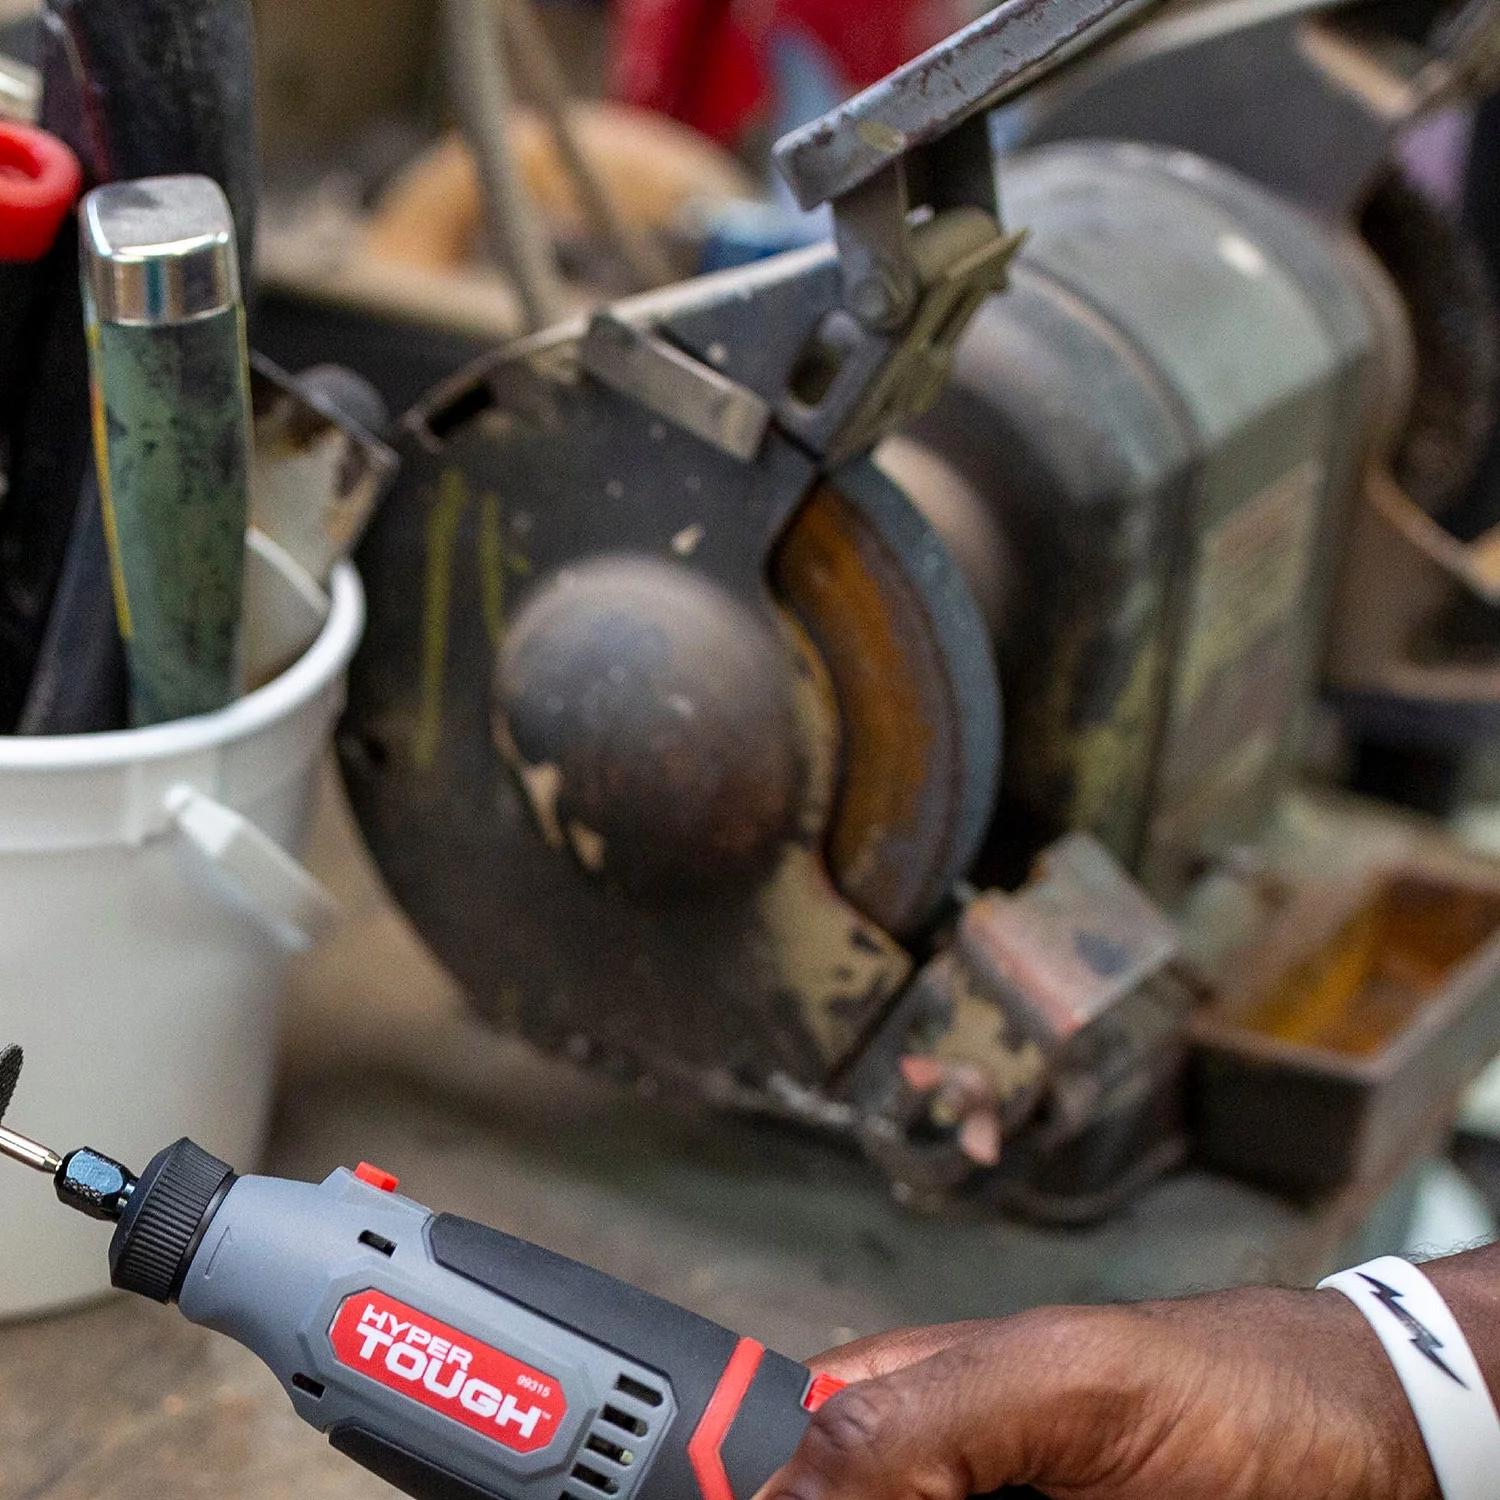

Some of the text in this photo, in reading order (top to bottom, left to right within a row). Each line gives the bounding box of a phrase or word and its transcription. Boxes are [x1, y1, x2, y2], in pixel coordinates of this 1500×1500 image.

[361, 1303, 473, 1371] HYPER
[356, 1322, 543, 1438] TOUGH
[516, 1374, 551, 1398] 99315
